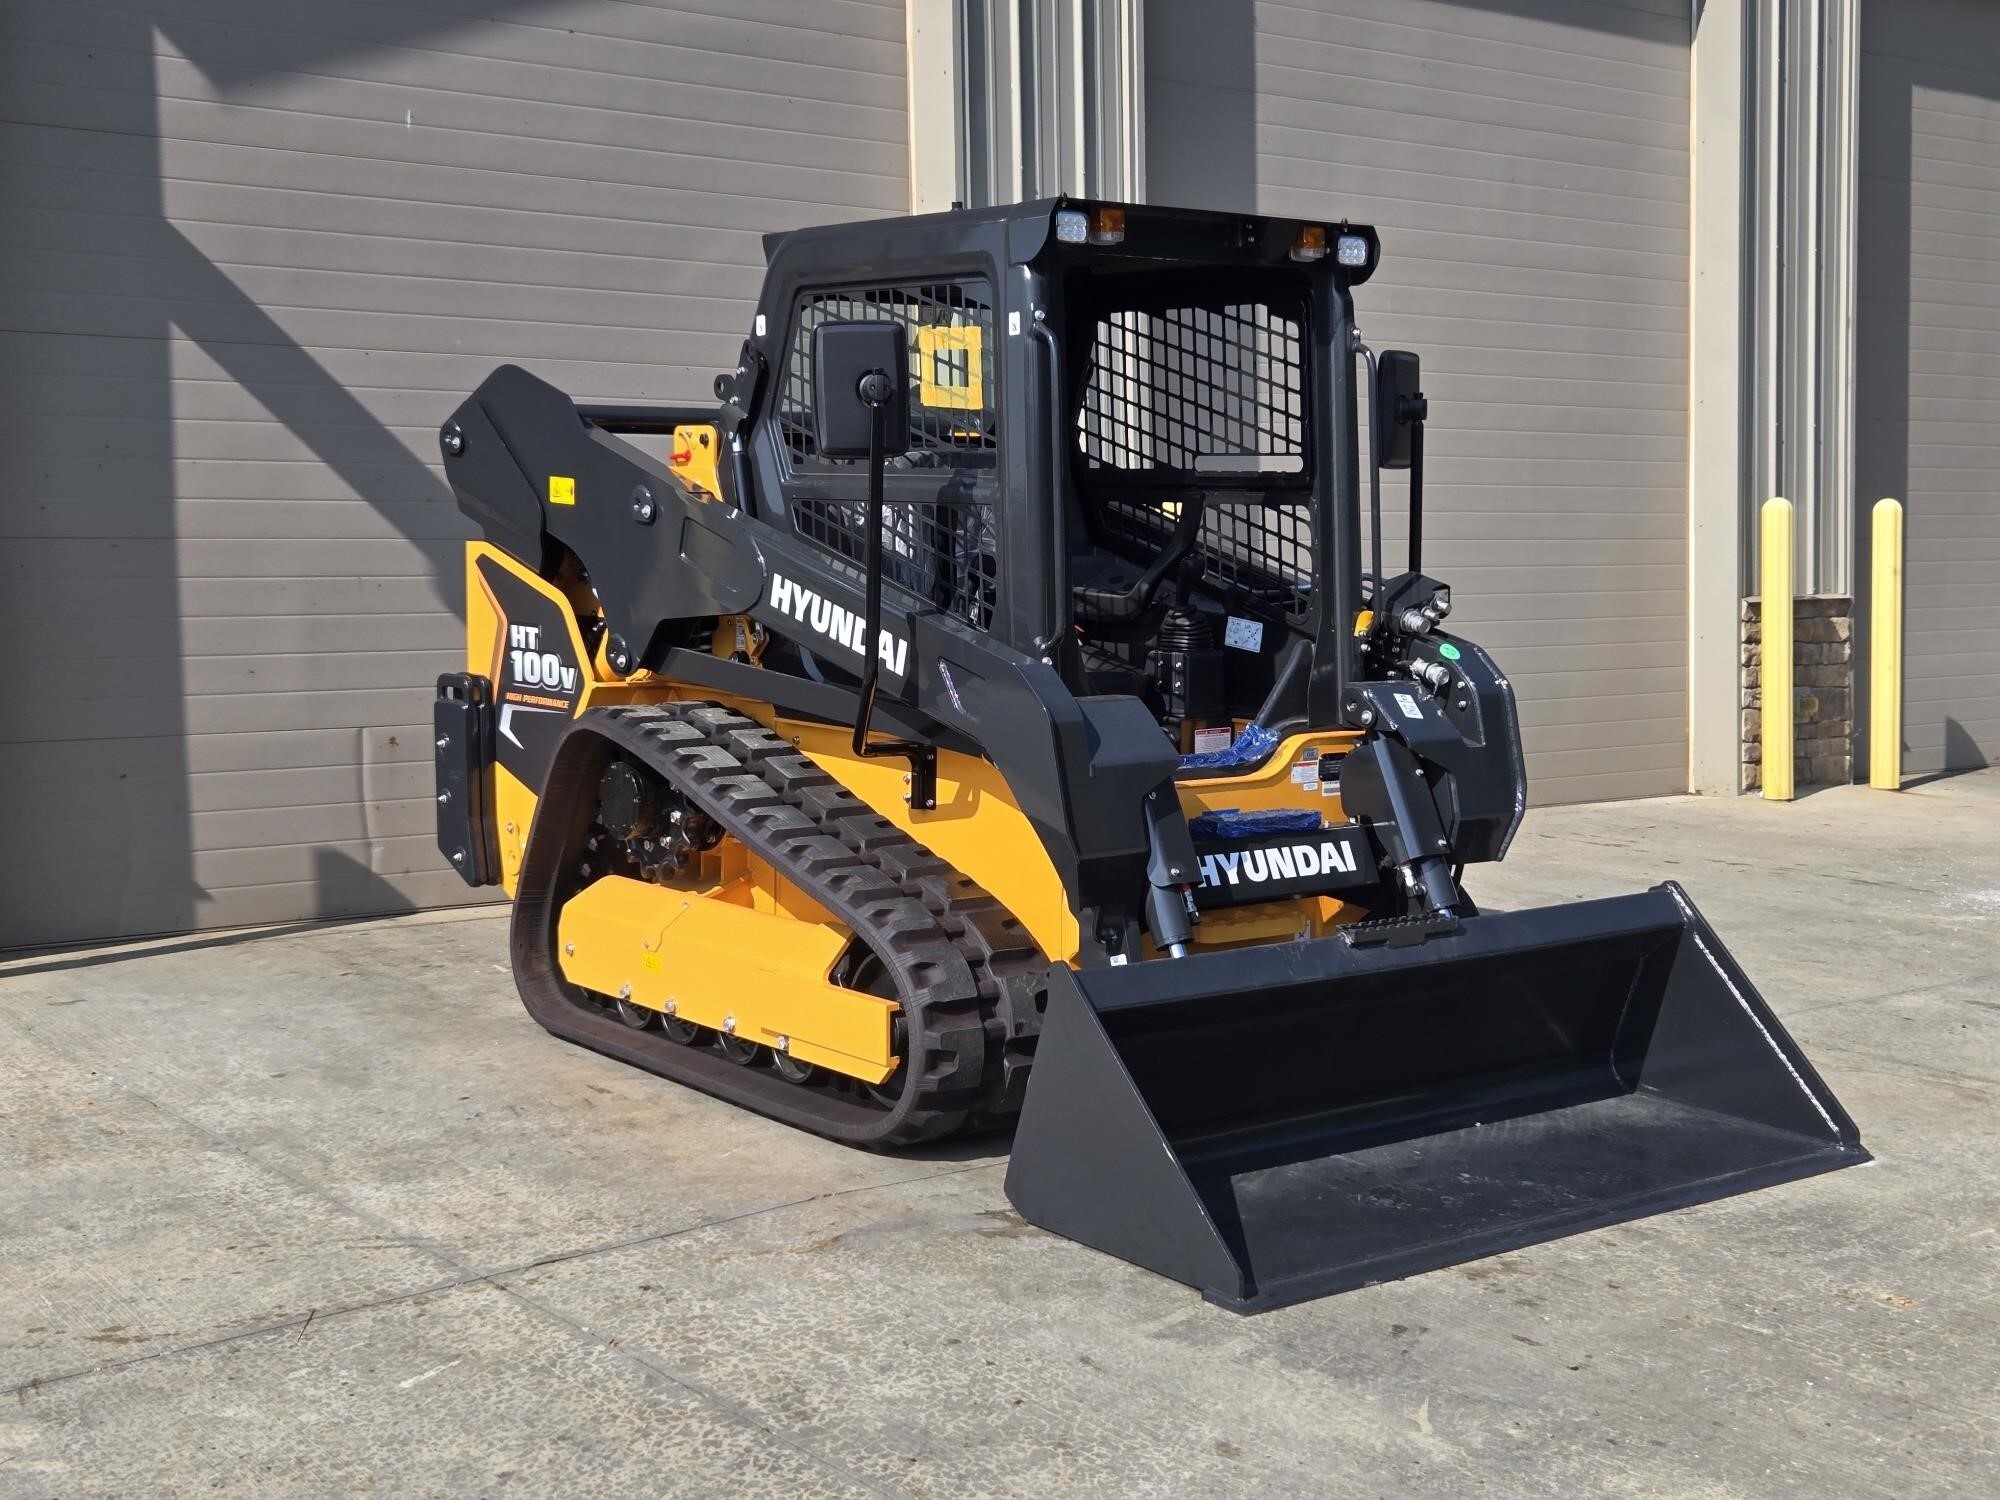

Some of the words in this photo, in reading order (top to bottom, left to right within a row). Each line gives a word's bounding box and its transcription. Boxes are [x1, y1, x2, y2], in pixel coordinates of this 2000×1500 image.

[510, 624, 540, 650] HT
[770, 572, 908, 677] HYUNDAI
[505, 692, 523, 702] HIGH
[522, 694, 570, 709] PERFORMANCE
[1196, 840, 1357, 888] HYUNDAI
